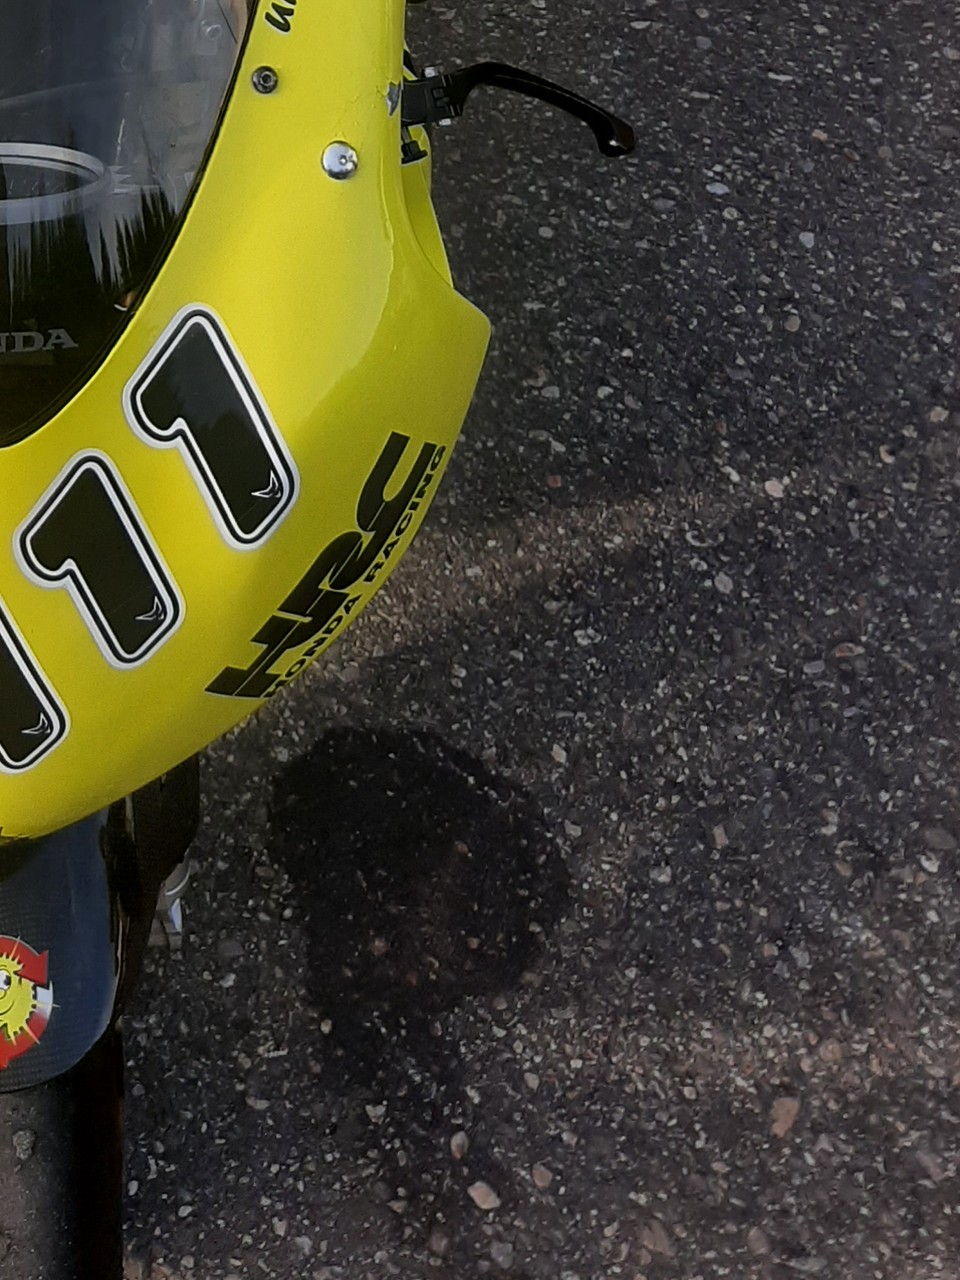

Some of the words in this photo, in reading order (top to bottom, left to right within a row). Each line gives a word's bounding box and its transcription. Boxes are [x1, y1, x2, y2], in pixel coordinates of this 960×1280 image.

[204, 431, 438, 698] HRC
[263, 593, 362, 698] HONDA
[364, 445, 447, 583] RACING
